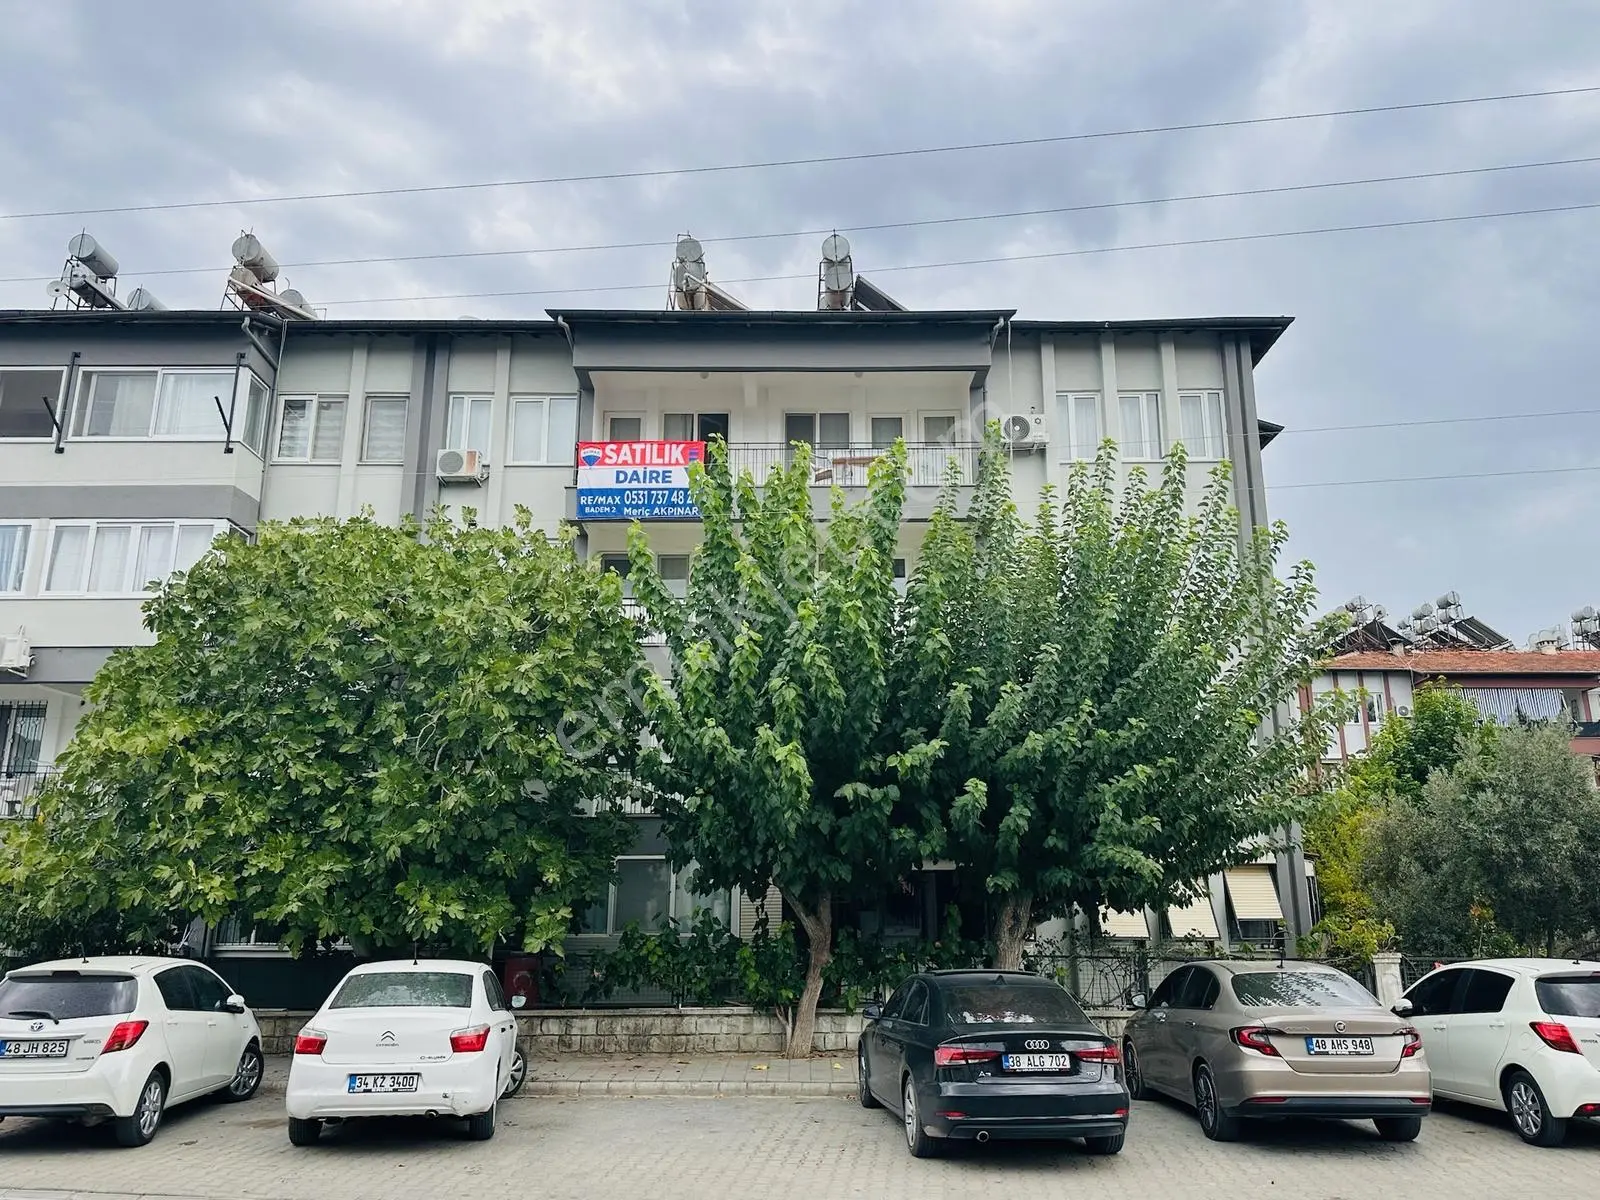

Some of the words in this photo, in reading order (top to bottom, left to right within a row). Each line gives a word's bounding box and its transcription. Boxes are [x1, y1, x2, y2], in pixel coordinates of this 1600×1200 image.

[604, 443, 685, 465] SATILIK
[615, 467, 672, 484] DAİRE
[580, 495, 621, 505] RE/MAX
[624, 490, 648, 505] 0531
[650, 490, 667, 505] 737
[671, 490, 684, 505] 48
[623, 507, 650, 517] Meriç
[653, 506, 699, 516] AKPINAR
[5, 1043, 20, 1053] 48
[23, 1042, 39, 1053] JH
[42, 1042, 65, 1053] 825
[1315, 1039, 1327, 1050] 48
[1331, 1039, 1349, 1050] AHS
[1352, 1039, 1371, 1050] 948
[1009, 1055, 1021, 1067] 38
[1027, 1055, 1045, 1067] ALG
[1049, 1055, 1067, 1067] 702
[356, 1076, 369, 1089] 34
[372, 1076, 385, 1088] KZ
[389, 1076, 415, 1088] 3400
